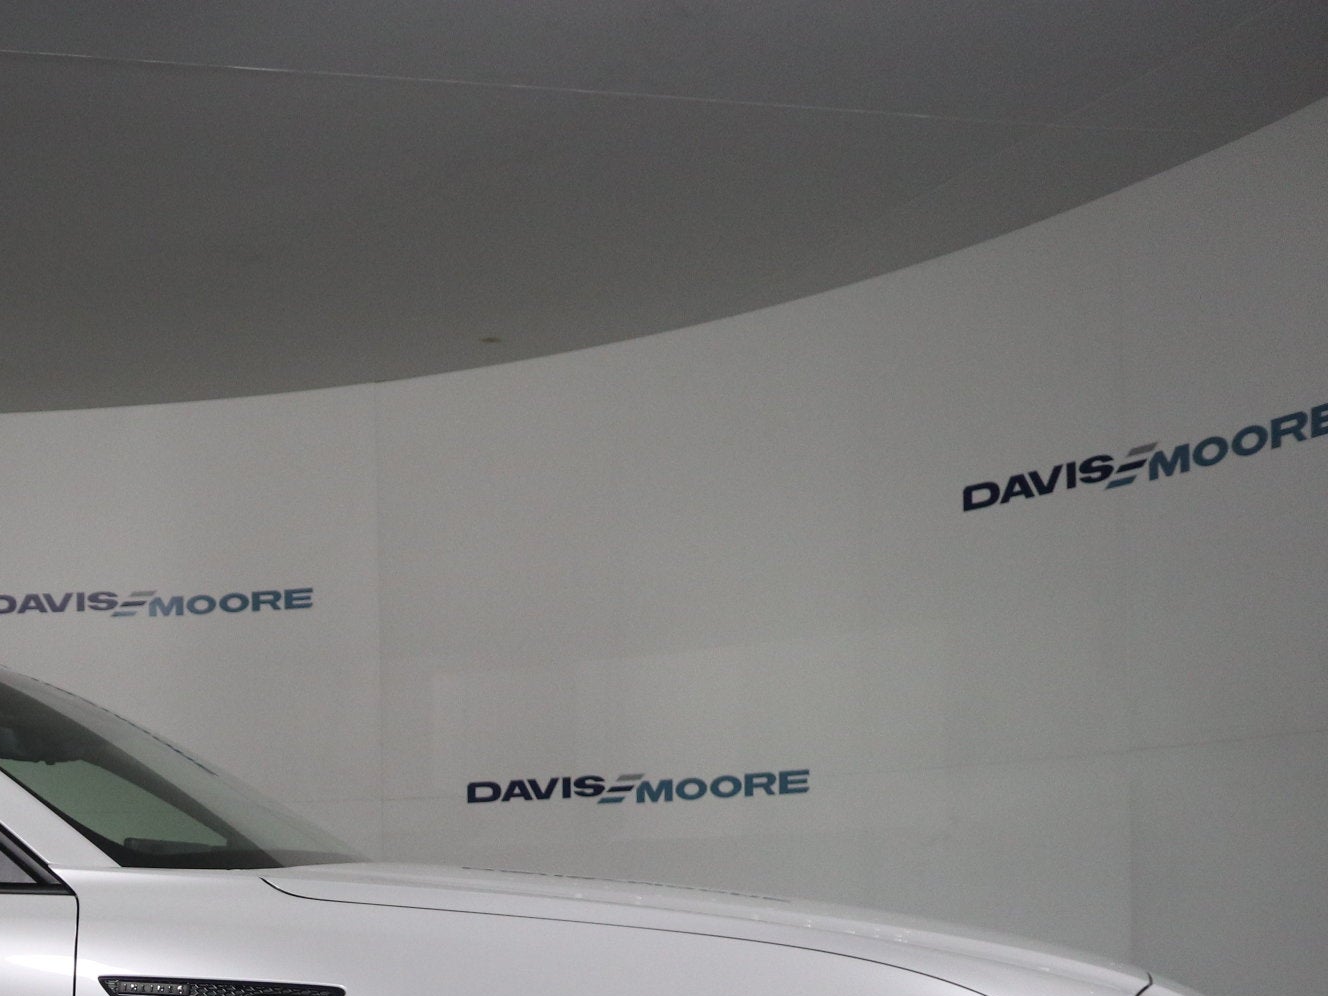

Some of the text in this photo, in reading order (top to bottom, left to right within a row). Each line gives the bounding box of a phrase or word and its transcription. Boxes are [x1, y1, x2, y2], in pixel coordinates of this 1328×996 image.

[962, 454, 1115, 512] DAVIS
[149, 587, 313, 617] MOORE
[467, 769, 810, 804] DAVIS MOORE
